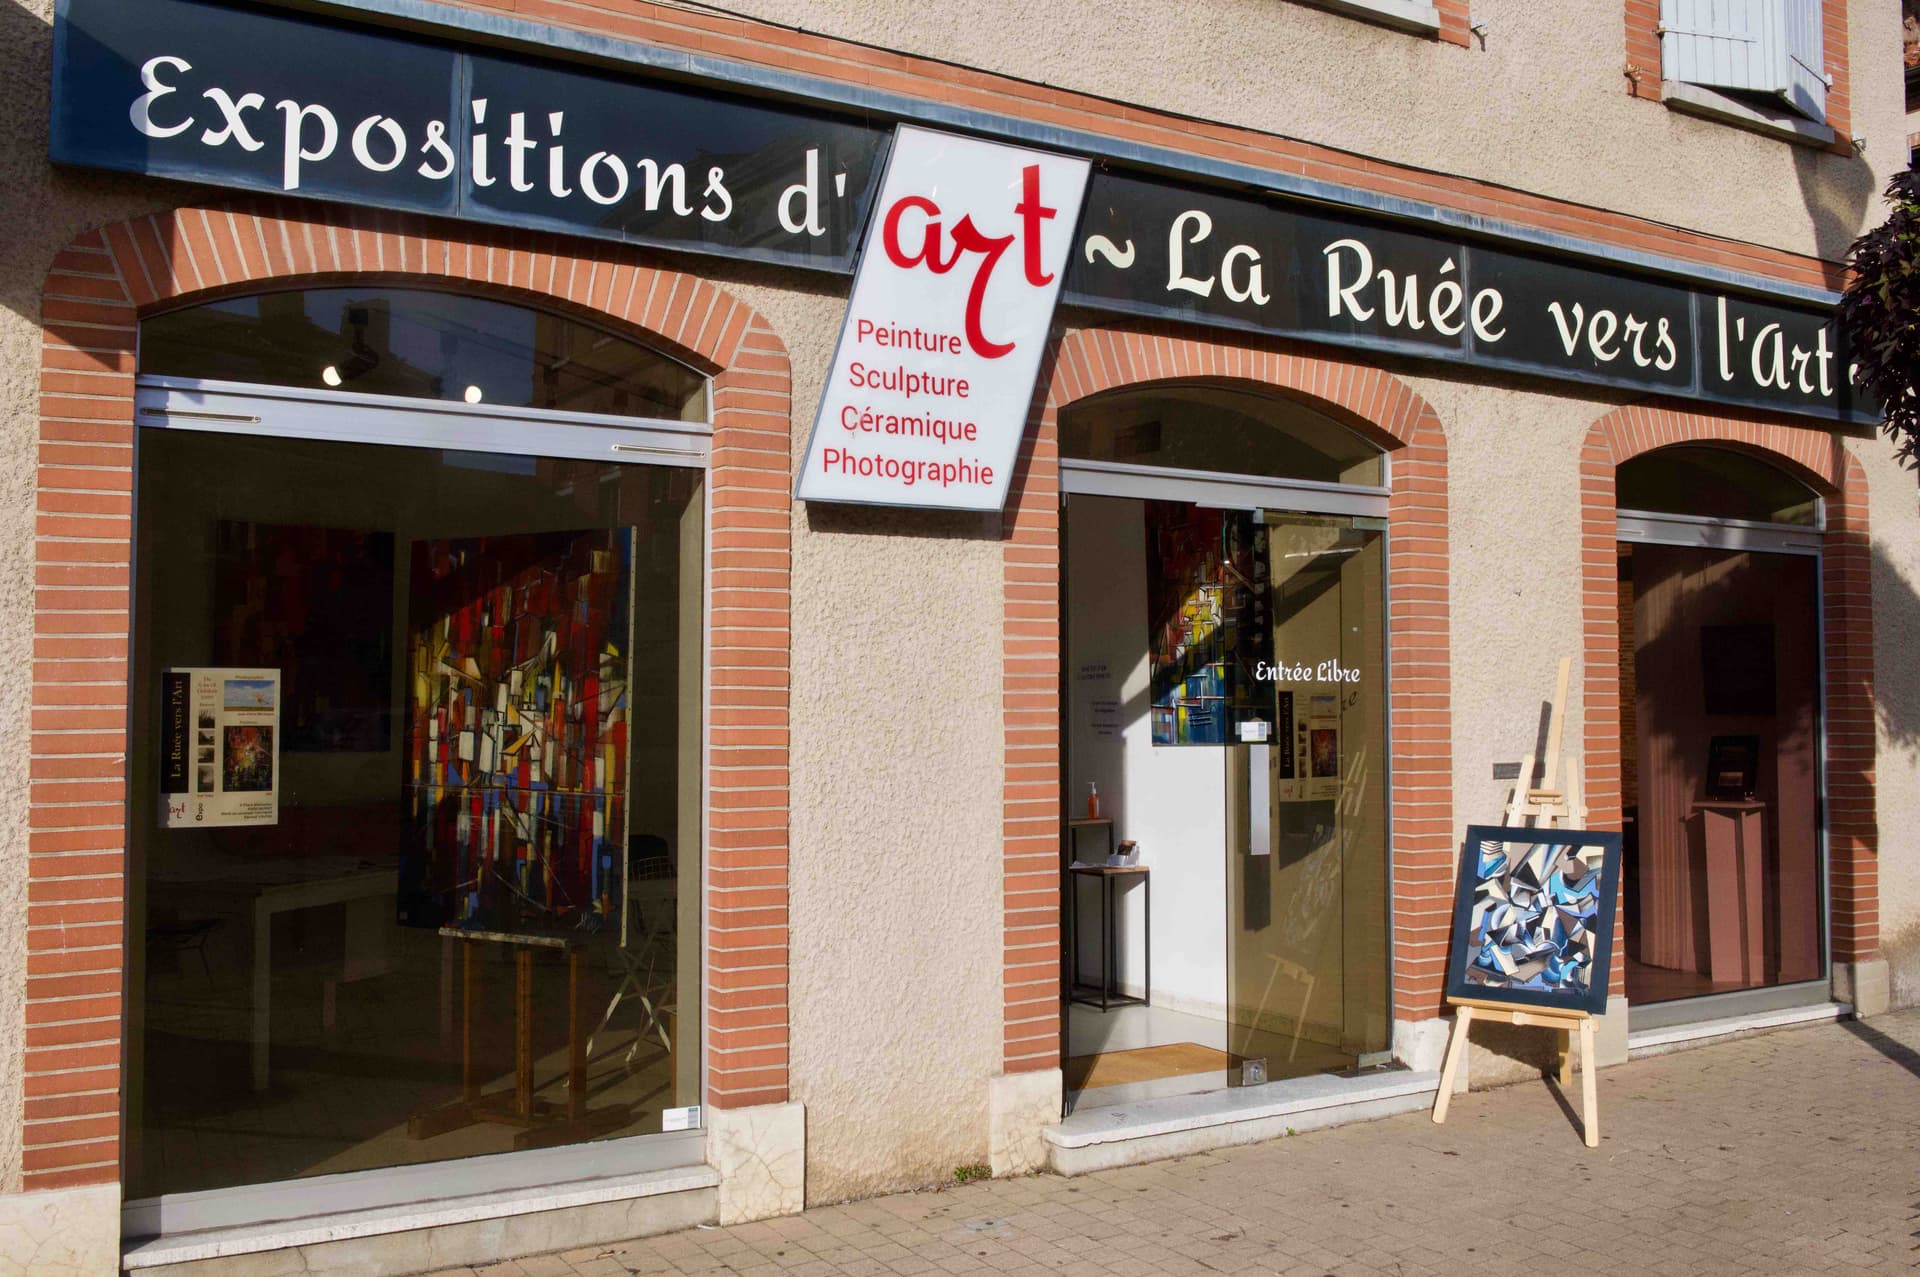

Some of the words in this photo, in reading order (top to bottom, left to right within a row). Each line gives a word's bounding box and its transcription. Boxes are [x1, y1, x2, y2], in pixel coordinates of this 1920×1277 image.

[130, 56, 733, 222] Expositions
[778, 148, 847, 237] d'
[881, 163, 1057, 360] art
[1166, 210, 1271, 306] La
[1324, 238, 1506, 342] Ruée
[1547, 301, 1676, 371] vers
[1717, 296, 1834, 397] l'Art
[856, 319, 962, 355] Peinture
[849, 362, 970, 398] Sculpture
[841, 404, 977, 445] Céramique
[823, 448, 994, 488] Photographie
[1255, 660, 1313, 683] Entrée
[1316, 658, 1361, 683] Libre
